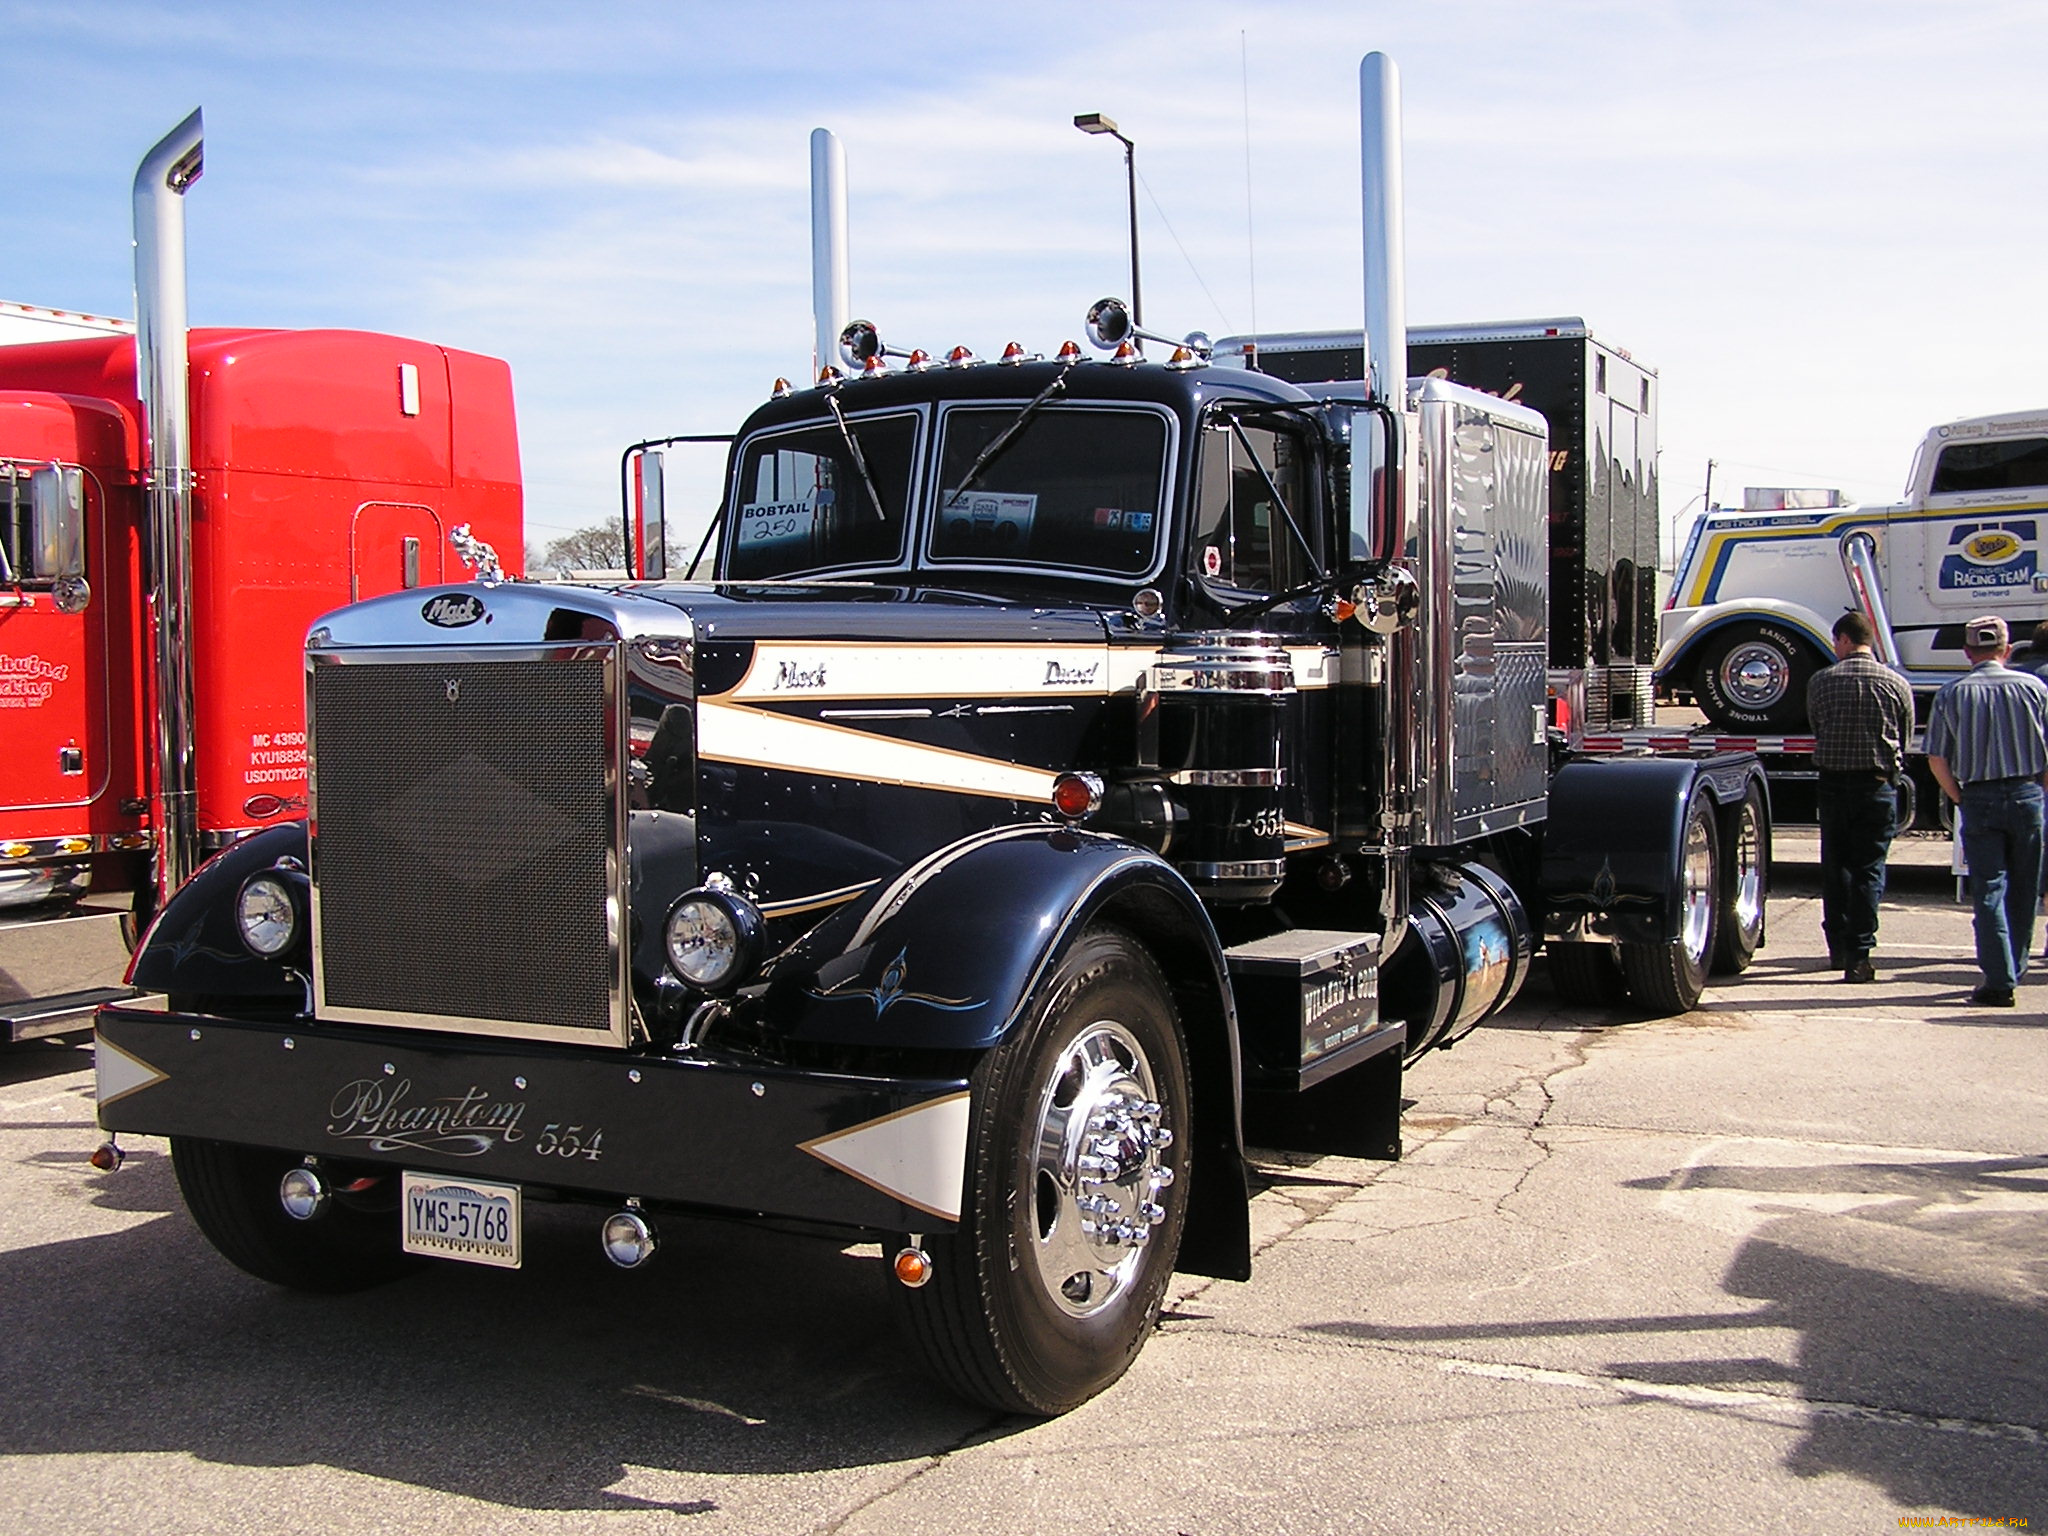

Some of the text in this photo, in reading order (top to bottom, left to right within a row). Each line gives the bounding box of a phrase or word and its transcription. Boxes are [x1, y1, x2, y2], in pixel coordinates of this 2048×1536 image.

[745, 503, 810, 518] BOBTAIL
[754, 518, 796, 539] 250
[1714, 515, 1817, 528] DETROIT DIESEL
[1999, 566, 2029, 583] TEAM
[427, 596, 477, 625] Mack
[1760, 628, 1797, 655] BANDAG
[1706, 669, 1725, 708] MALONE
[1729, 709, 1769, 721] TYRONE
[252, 732, 307, 747] MC 43190
[326, 1077, 605, 1161] Phantom 554
[413, 1197, 508, 1242] YMS-5768
